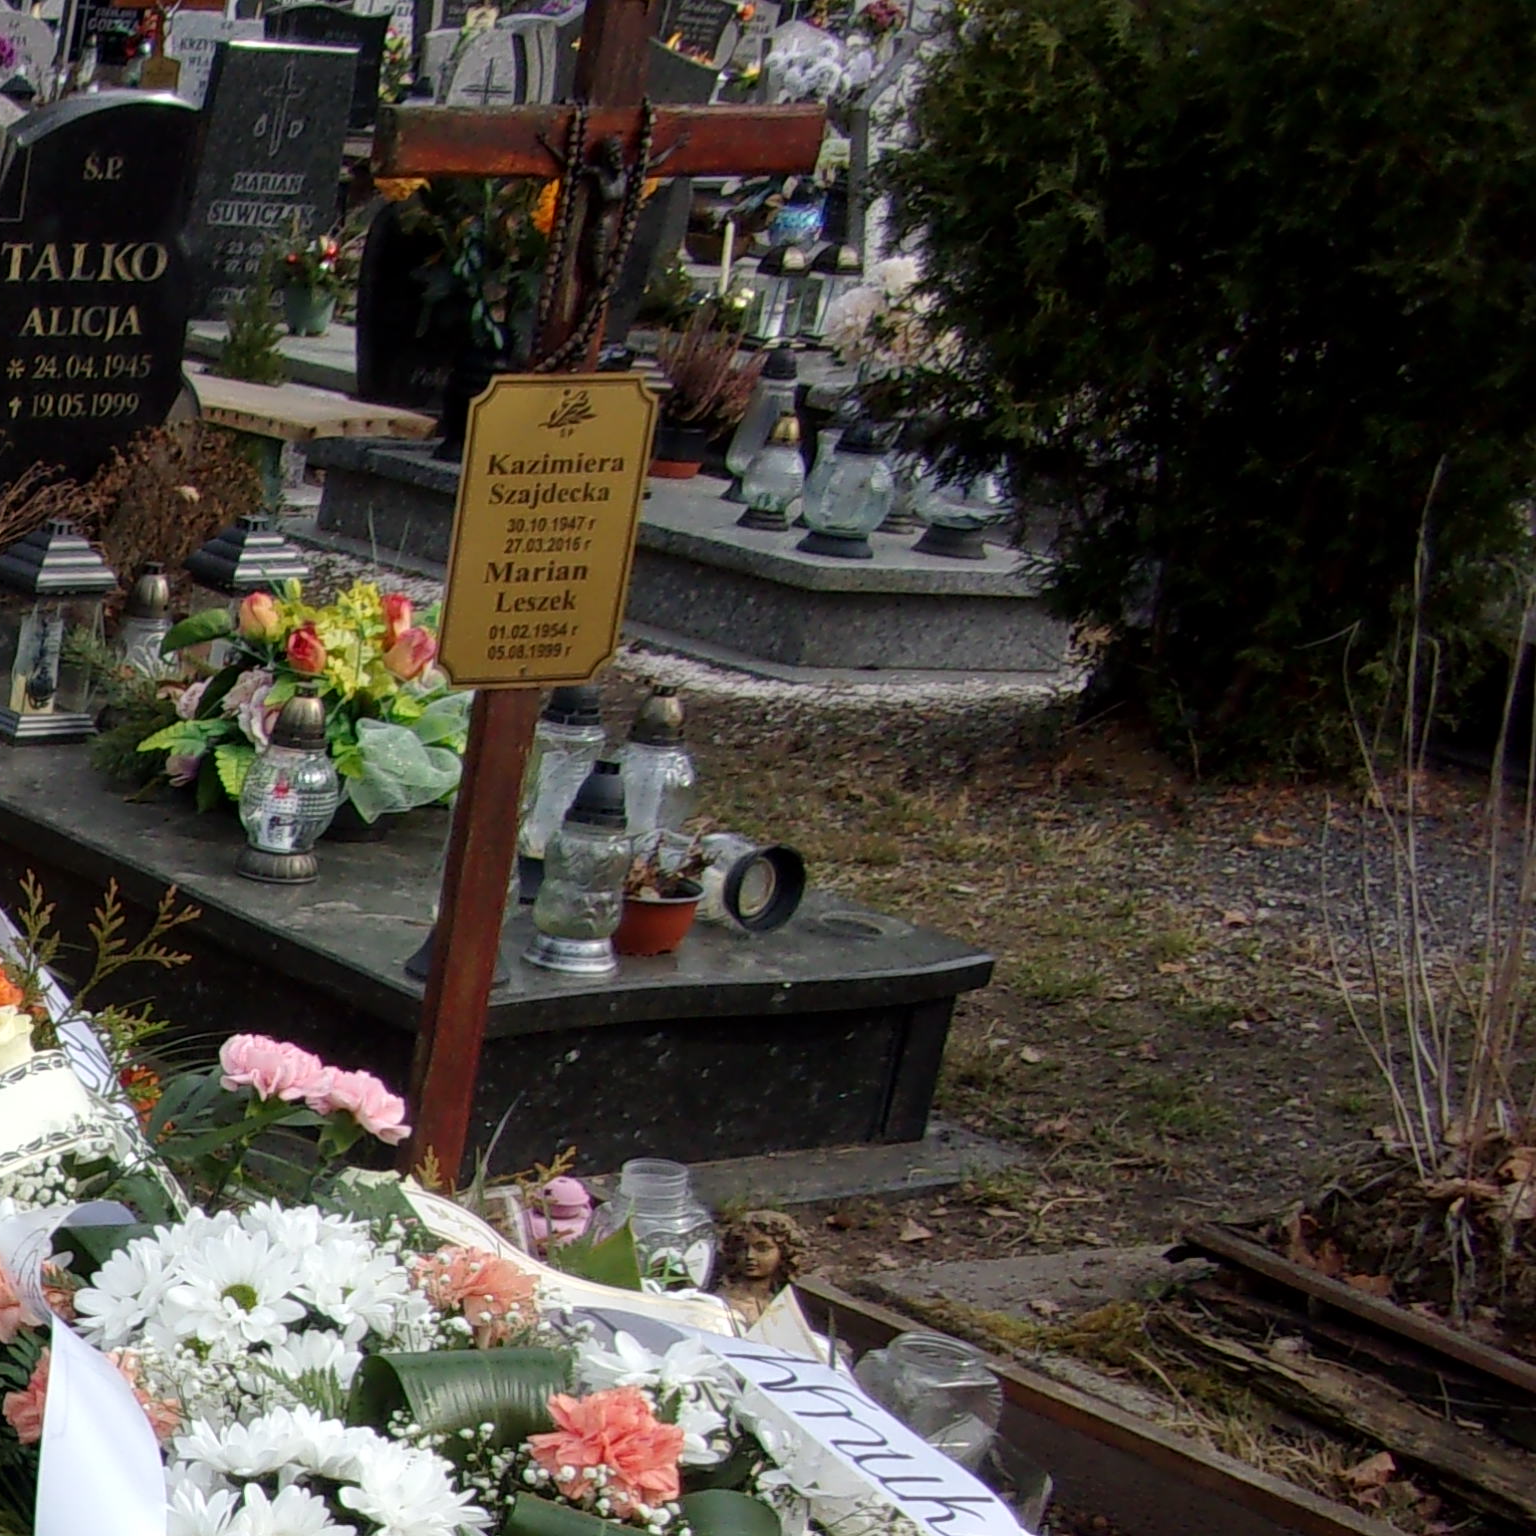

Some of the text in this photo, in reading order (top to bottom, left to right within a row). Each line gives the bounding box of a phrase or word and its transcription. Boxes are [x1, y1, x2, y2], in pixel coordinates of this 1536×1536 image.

[84, 149, 124, 182] Ś.P.
[231, 171, 305, 195] MARIAN
[1, 241, 168, 283] TALKO
[18, 304, 144, 343] ALICJA
[486, 450, 626, 476] Kazimiera
[488, 481, 611, 510] Szajdecka
[503, 535, 583, 554] 27.03.2016
[484, 559, 590, 584] Marian
[494, 589, 578, 614] Leszek
[488, 621, 569, 641] 01.02.1954
